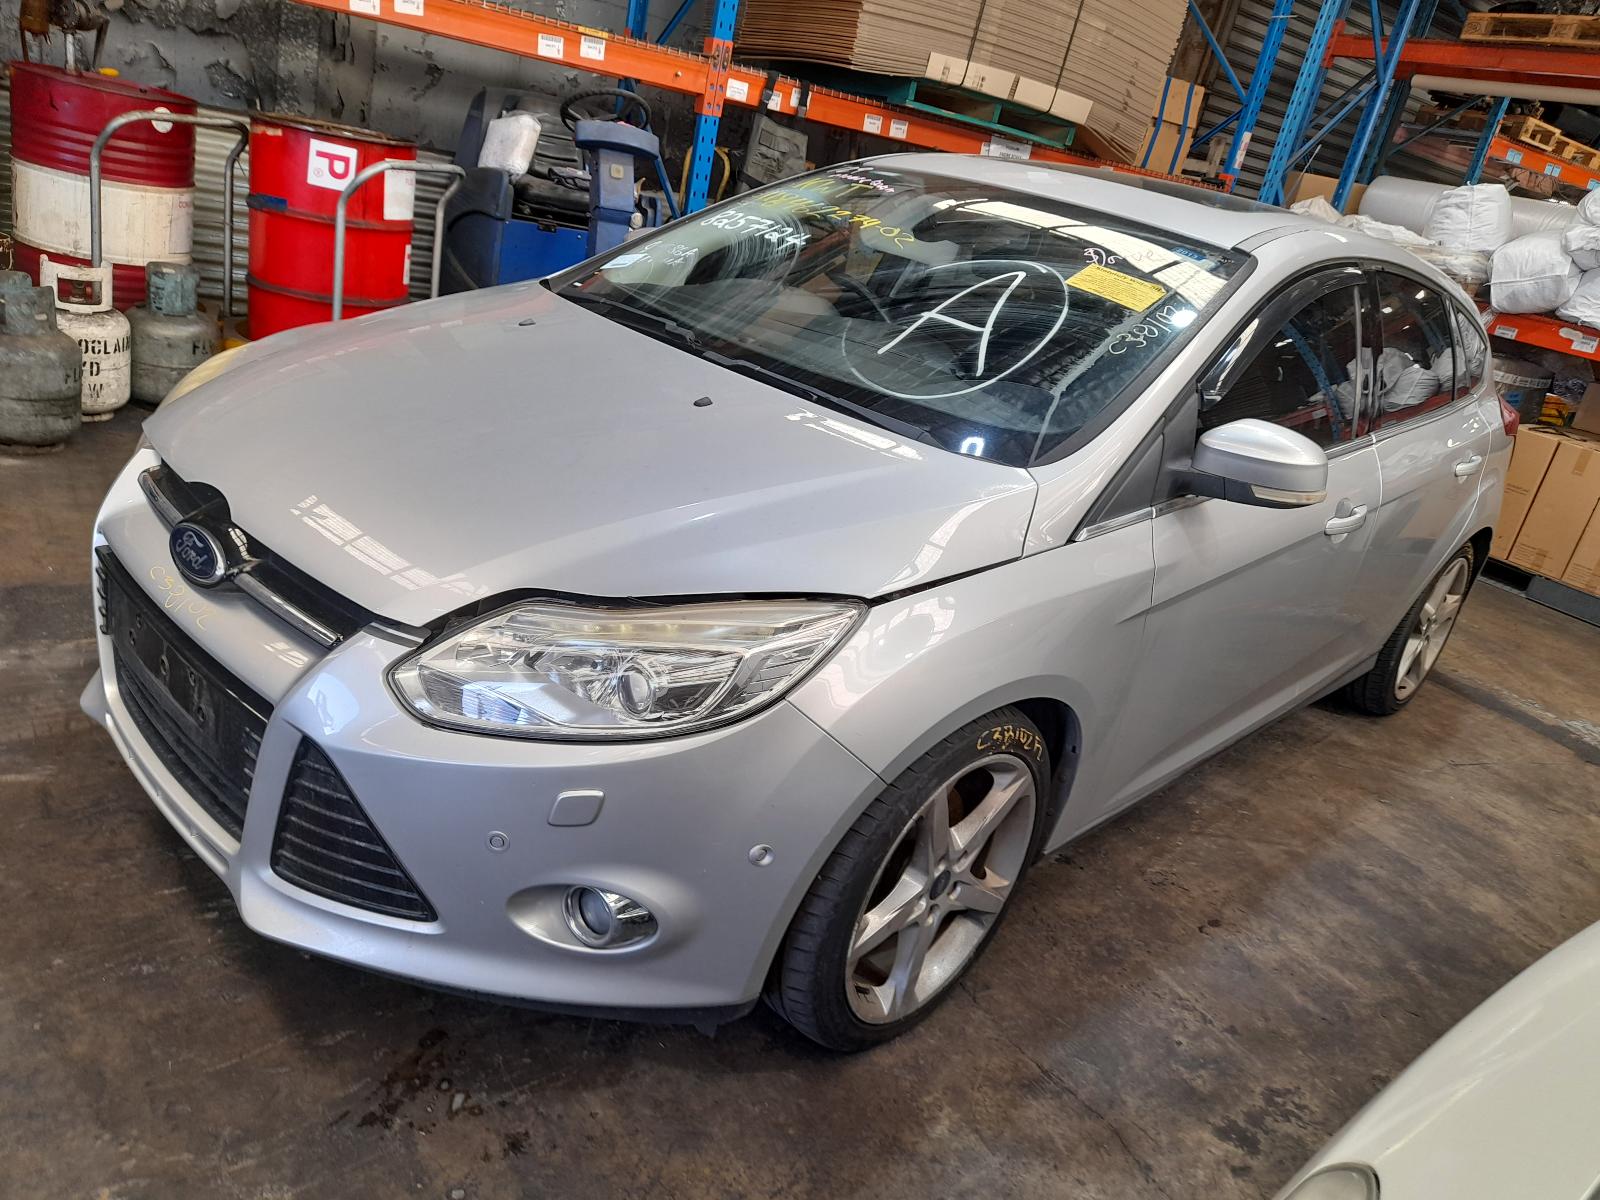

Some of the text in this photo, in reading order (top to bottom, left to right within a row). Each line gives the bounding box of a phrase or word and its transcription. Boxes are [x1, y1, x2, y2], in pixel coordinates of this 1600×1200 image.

[315, 150, 351, 180] P
[876, 270, 1027, 377] A
[175, 530, 208, 570] Ford
